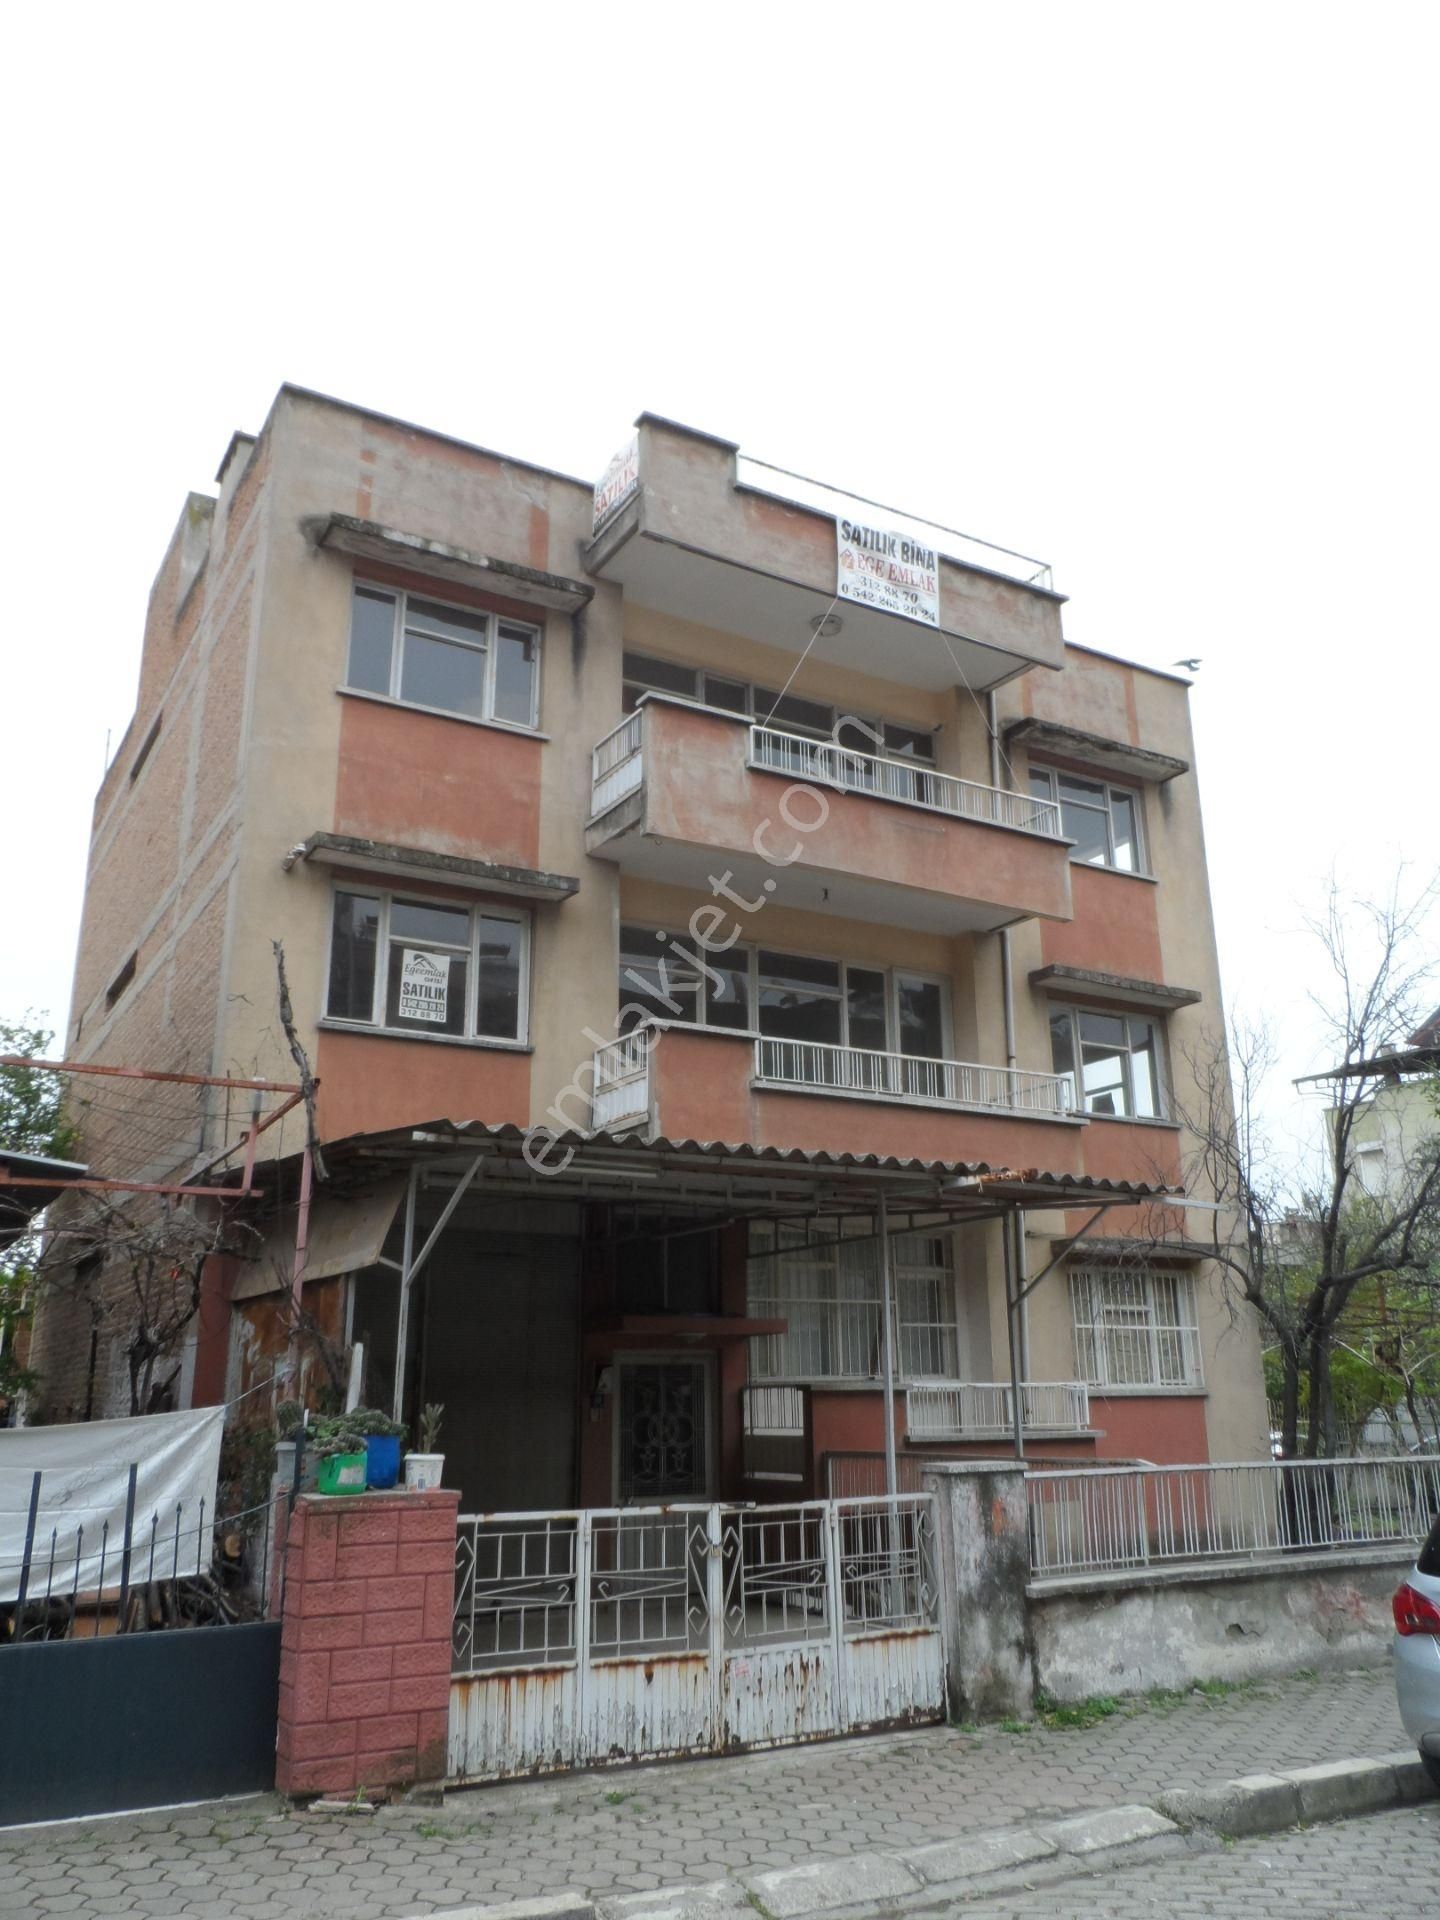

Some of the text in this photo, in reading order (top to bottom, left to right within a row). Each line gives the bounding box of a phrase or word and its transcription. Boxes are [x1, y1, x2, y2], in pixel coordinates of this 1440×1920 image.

[841, 520, 936, 572] SATILIK BİNA
[857, 552, 936, 594] EGE EMLAK
[841, 583, 849, 594] 0
[852, 587, 875, 603] 542
[860, 575, 919, 604] 312 88 70
[402, 981, 446, 1001] SATILIK
[400, 1007, 417, 1017] 312
[433, 1013, 445, 1022] 70
